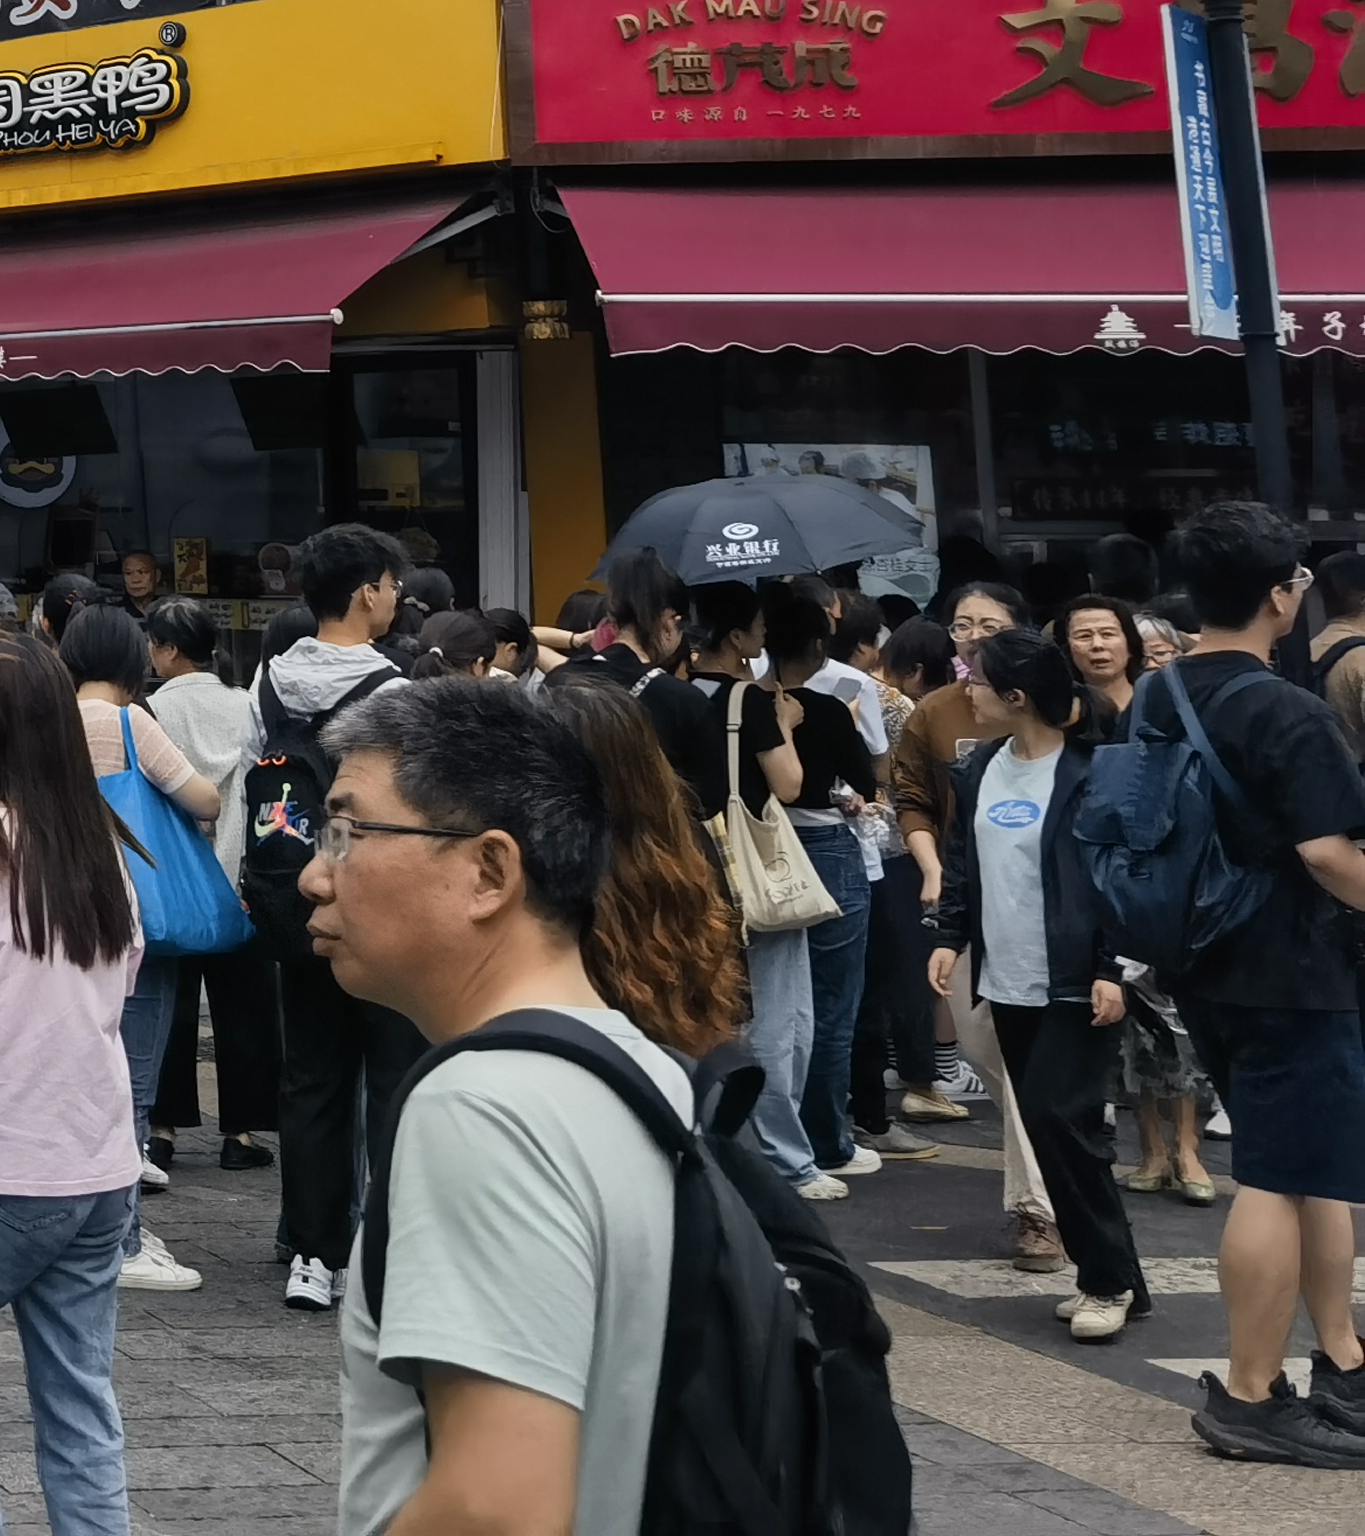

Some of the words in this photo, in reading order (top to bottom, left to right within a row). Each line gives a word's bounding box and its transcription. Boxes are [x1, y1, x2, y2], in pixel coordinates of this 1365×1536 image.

[614, 0, 693, 40] DAK
[766, 104, 863, 122] 一九七九
[55, 121, 94, 145] HEI
[95, 117, 139, 142] YA
[706, 538, 780, 557] 兴业银行
